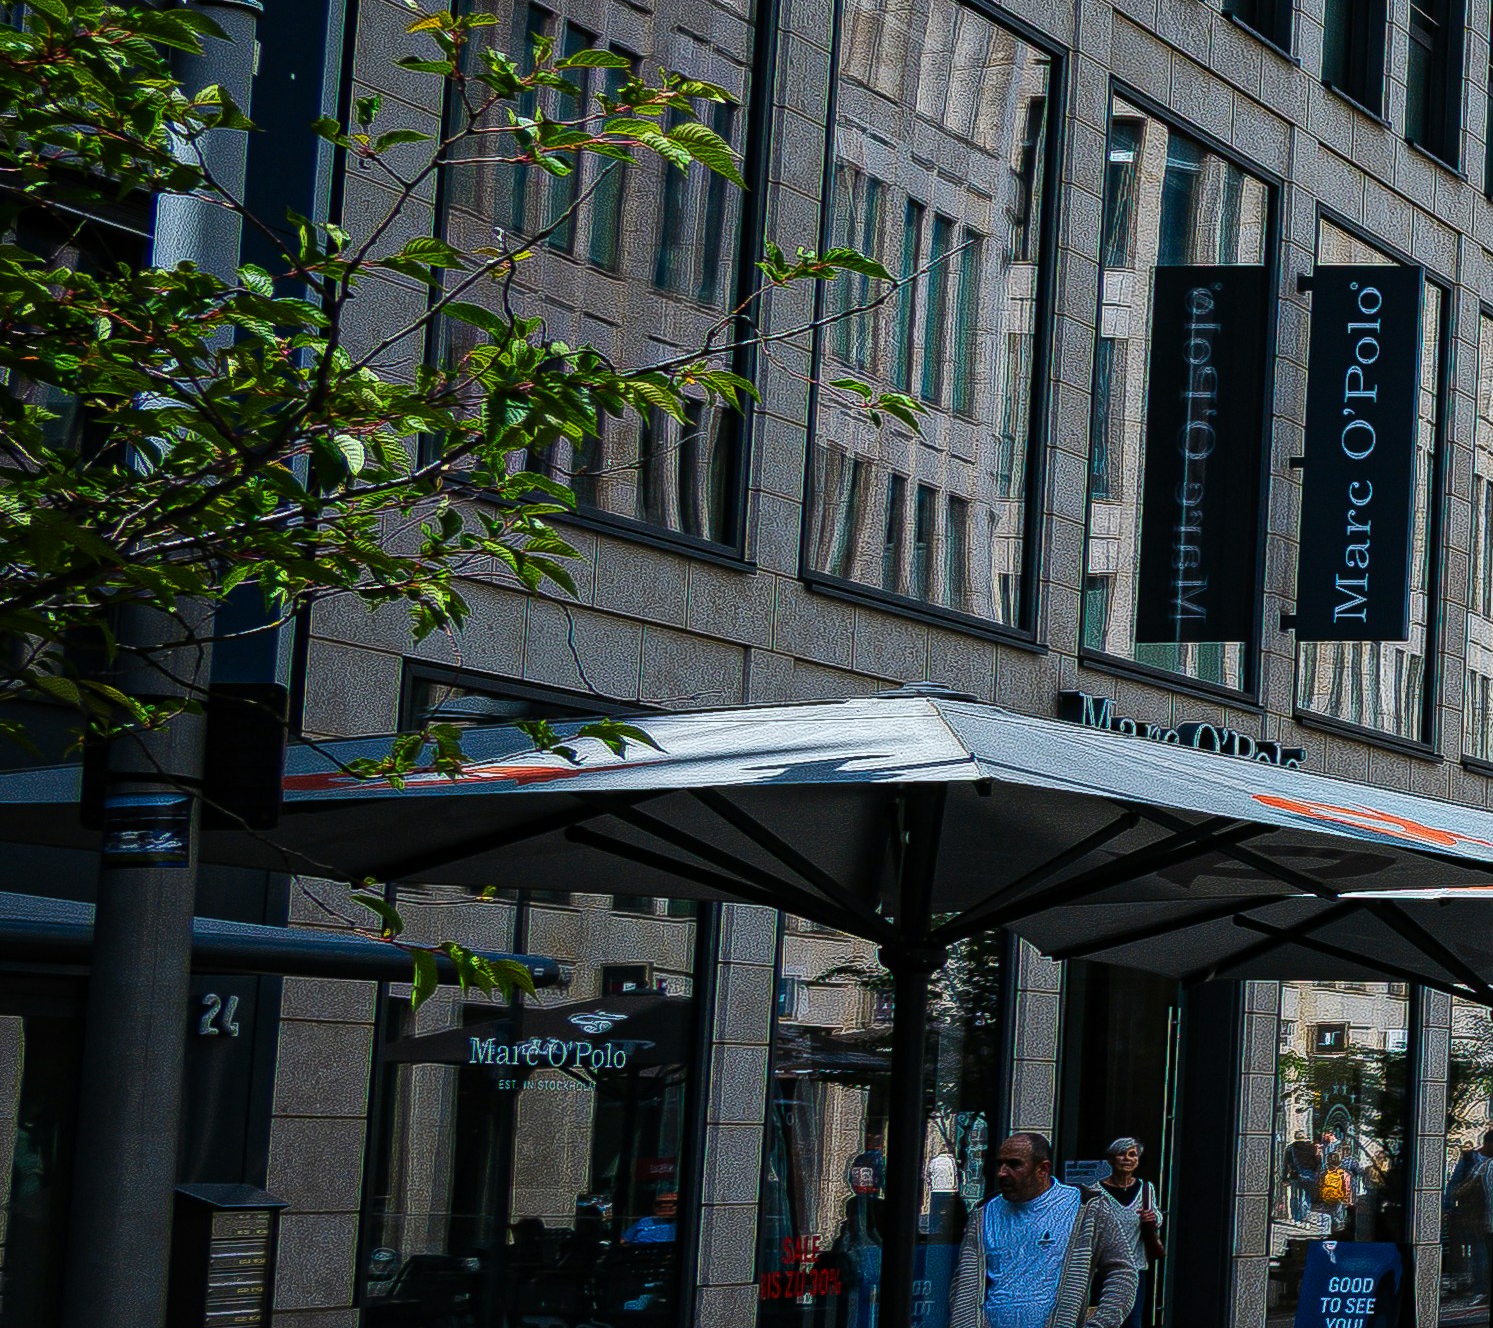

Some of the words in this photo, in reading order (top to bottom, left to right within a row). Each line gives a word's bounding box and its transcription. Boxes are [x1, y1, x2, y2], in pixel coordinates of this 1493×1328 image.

[1333, 479, 1373, 624] Marc
[468, 1037, 540, 1066] Marc
[1328, 1276, 1375, 1294] GOOD
[1320, 1297, 1341, 1314] TO
[1344, 1297, 1377, 1315] SEE
